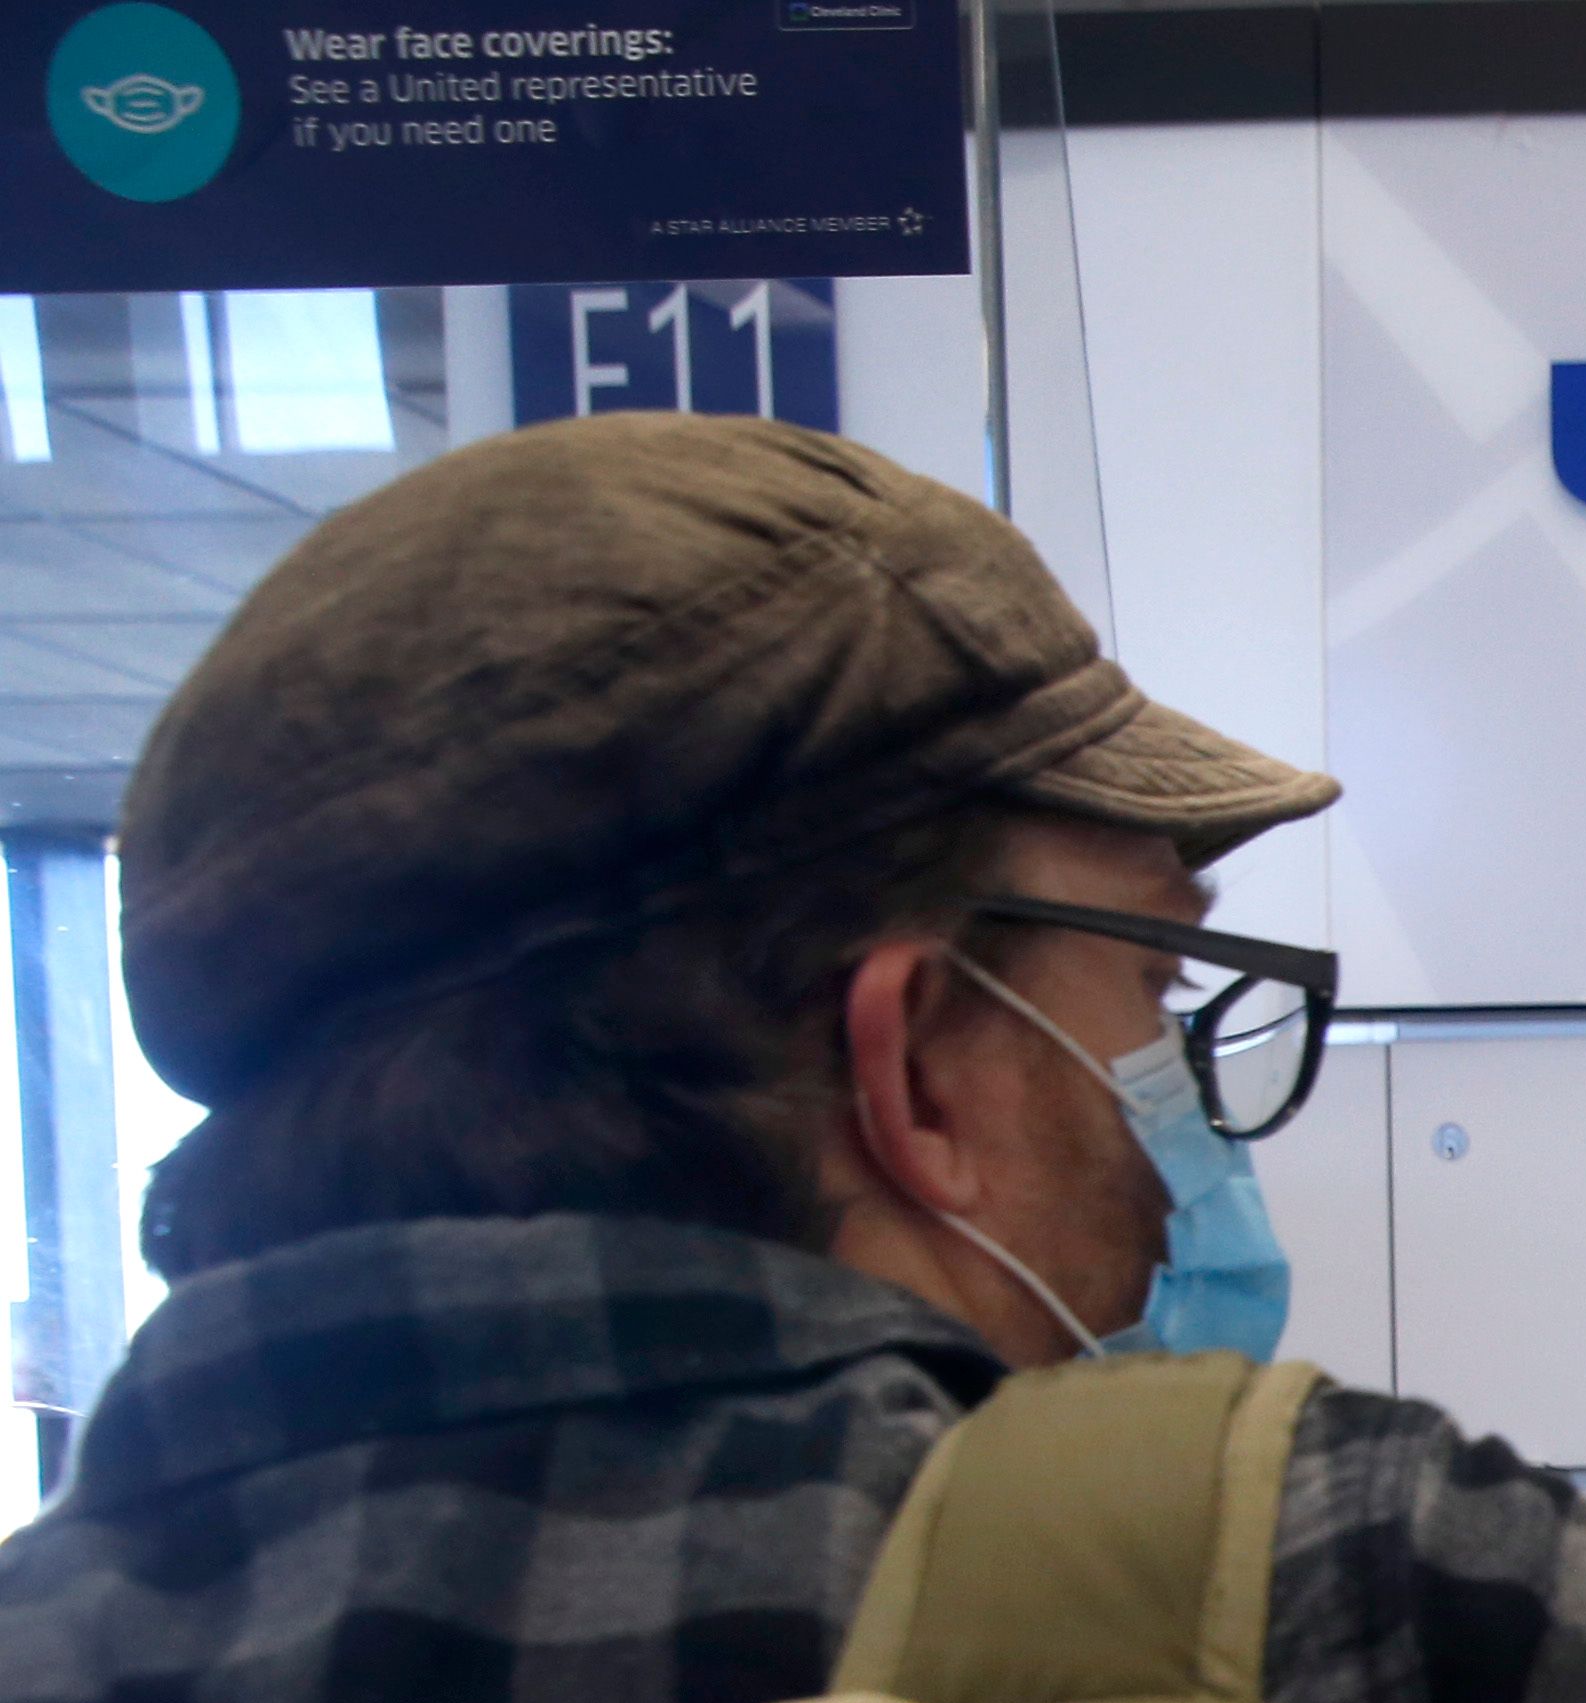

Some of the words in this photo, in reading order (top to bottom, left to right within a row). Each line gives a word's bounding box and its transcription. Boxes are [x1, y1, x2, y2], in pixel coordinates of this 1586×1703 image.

[283, 28, 387, 61] Wear
[395, 26, 473, 59] face
[482, 23, 673, 61] coverings:
[289, 74, 351, 104] See
[359, 79, 380, 102] a
[388, 71, 501, 102] United
[510, 67, 758, 105] representative
[292, 117, 320, 147] if
[327, 122, 392, 152] you
[402, 114, 485, 145] need
[494, 118, 557, 143] one
[651, 220, 664, 235] A
[666, 219, 713, 235] STAR
[718, 217, 807, 234] ALLIANCE
[811, 215, 891, 232] MEMBER
[570, 280, 775, 420] F11
